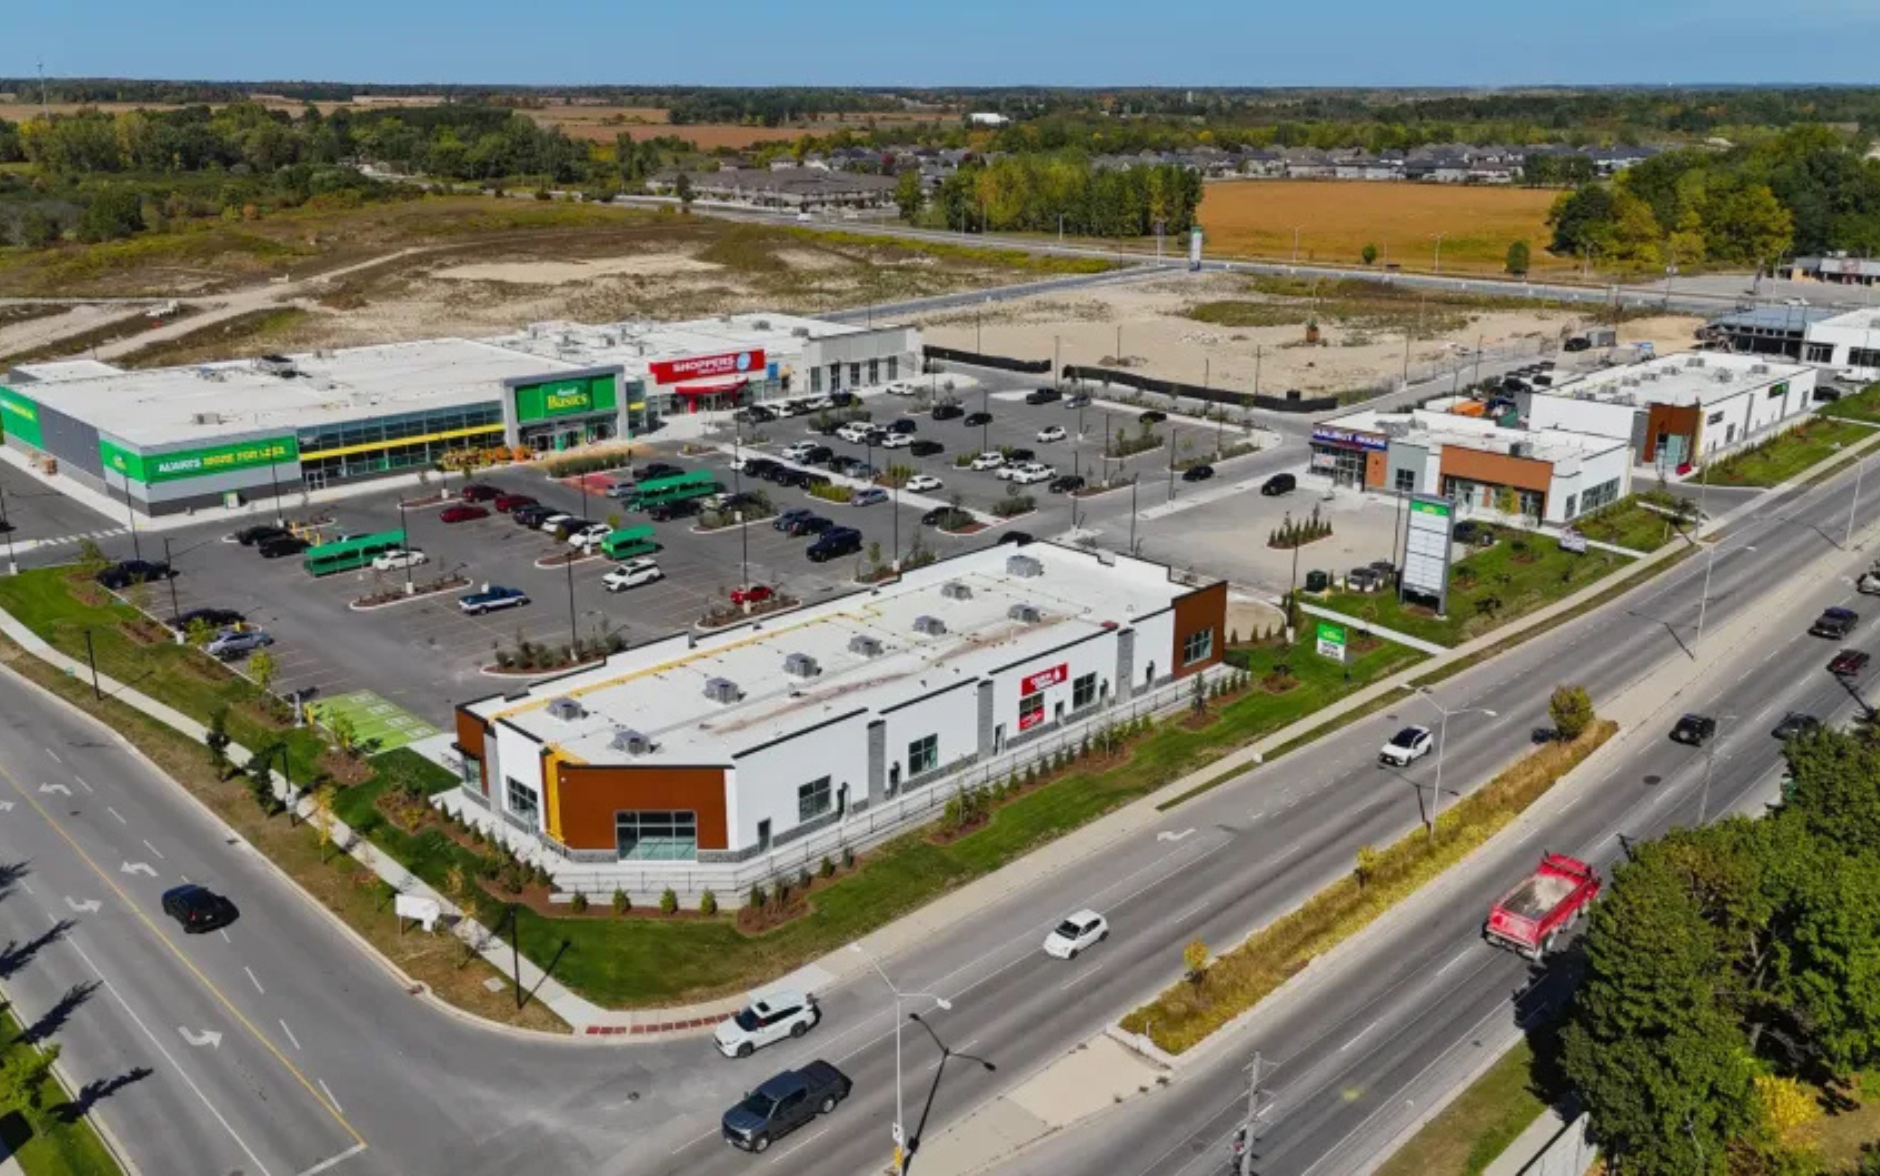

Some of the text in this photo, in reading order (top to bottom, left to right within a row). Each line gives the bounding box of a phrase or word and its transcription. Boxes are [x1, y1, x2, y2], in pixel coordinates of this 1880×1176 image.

[672, 355, 735, 373] SHOPPERS
[547, 393, 588, 410] Basics
[158, 457, 201, 473] ALWAYS
[237, 450, 258, 462] FOR
